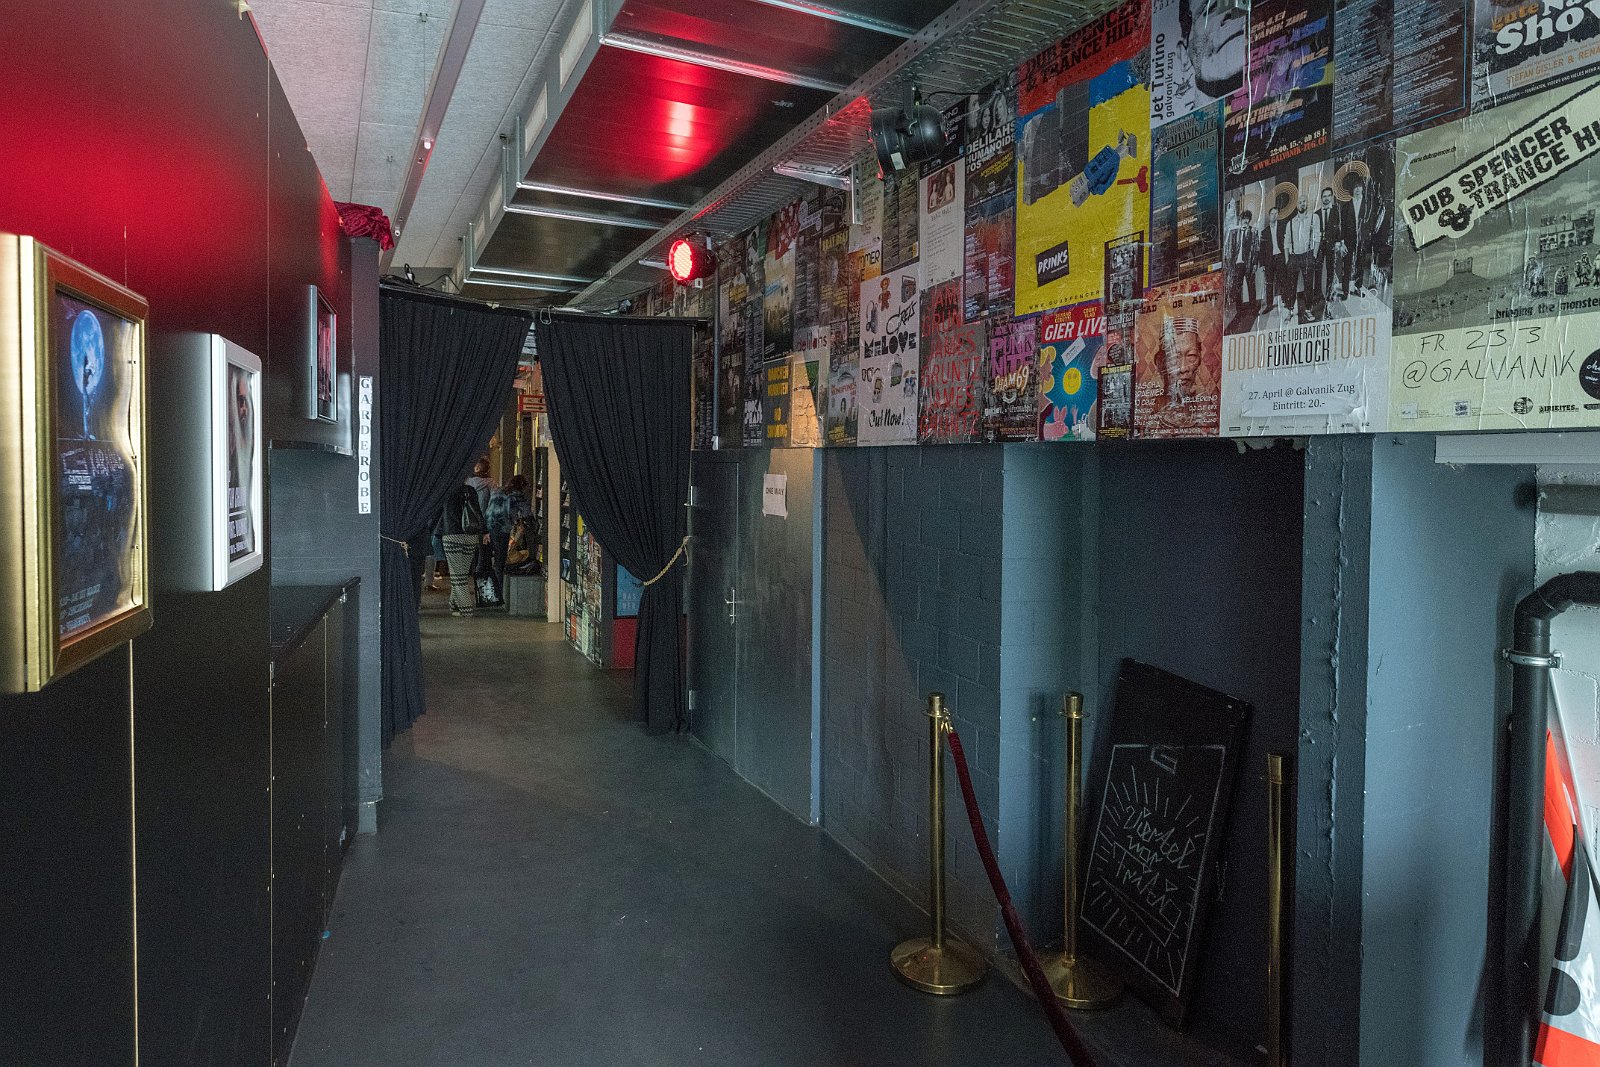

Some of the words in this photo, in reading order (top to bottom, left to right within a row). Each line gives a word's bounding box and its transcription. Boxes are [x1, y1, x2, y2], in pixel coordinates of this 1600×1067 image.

[1152, 33, 1165, 89] Turino
[1167, 52, 1175, 71] zug
[1535, 58, 1564, 75] GISLER
[1567, 55, 1575, 64] &
[1165, 73, 1174, 118] galvanik
[1151, 99, 1164, 120] Jet
[1408, 186, 1455, 225] DUB
[1458, 116, 1573, 195] SPENCER
[1469, 141, 1570, 209] TRANCE
[1037, 249, 1068, 275] DRINKS
[1172, 300, 1183, 309] OR
[1538, 302, 1555, 313] the
[1560, 297, 1600, 311] monste
[1044, 321, 1075, 341] GIER
[1077, 316, 1107, 337] LIVE
[1268, 331, 1273, 344] &
[1275, 329, 1287, 343] THE
[1288, 323, 1331, 341] LIBERATORS
[1228, 333, 1266, 372] DODO
[1267, 338, 1330, 368] FUNKLOCH
[1332, 317, 1376, 361] TOUR
[1402, 350, 1575, 389] @GALVANIK
[1248, 391, 1261, 400] 27.
[1262, 389, 1283, 401] April
[1285, 388, 1294, 398] @
[1296, 384, 1335, 396] Galvanik
[1337, 383, 1355, 395] Zug
[1273, 401, 1306, 411] Eintritt:
[1308, 399, 1325, 409] 20.-
[359, 378, 370, 513] GARDEROBE
[765, 487, 774, 495] ONE
